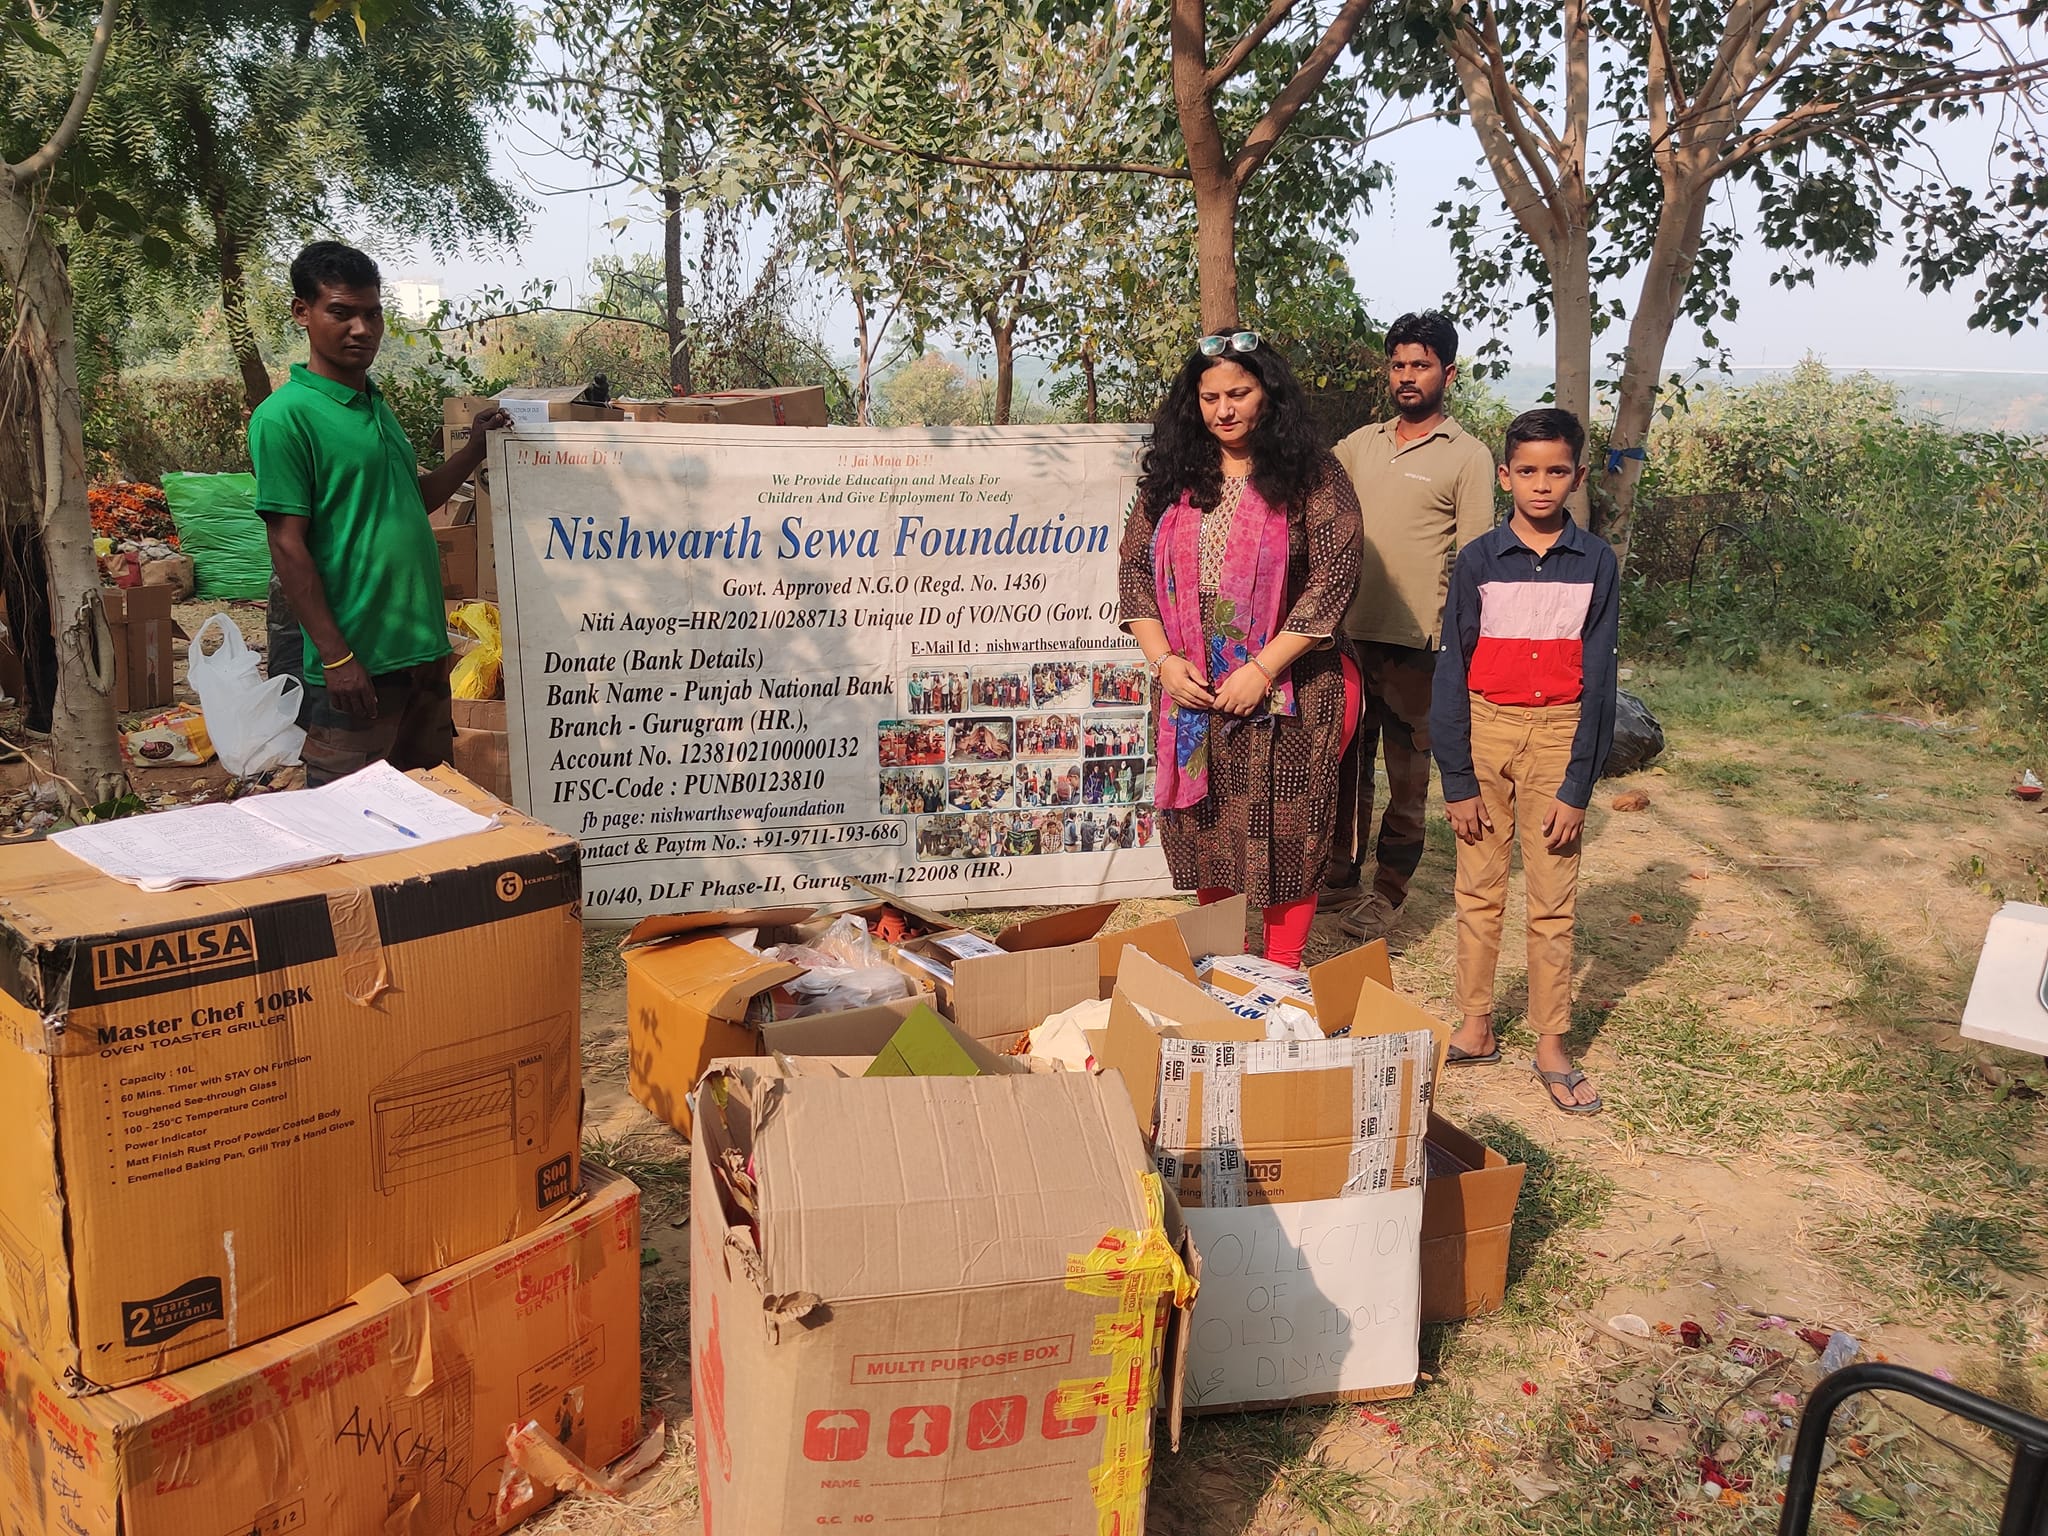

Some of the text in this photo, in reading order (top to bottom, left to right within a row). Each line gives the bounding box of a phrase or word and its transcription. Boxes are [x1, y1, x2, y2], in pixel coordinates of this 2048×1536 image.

[532, 450, 551, 466] Jai
[555, 451, 588, 465] Mata
[592, 450, 608, 465] Di
[851, 454, 869, 468] Jai
[873, 455, 901, 467] Mata
[906, 455, 919, 467] Di
[771, 474, 1000, 486] We Provide Education and Meals For
[758, 491, 1014, 506] Children And Give Employment To Needy
[544, 513, 1110, 560] Nishwarth Sewa Foundation
[722, 572, 1048, 600] Govt. Approved N.G.O (Regd. No. 1436)
[580, 612, 615, 632] Niti
[853, 608, 914, 631] Unique
[918, 606, 941, 626] ID
[945, 606, 965, 629] of
[970, 603, 1042, 625] VO/NGO
[1046, 603, 1093, 626] (Govt.
[544, 648, 764, 675] Donate (Bank Details)
[911, 640, 955, 655] E-Mail
[958, 640, 971, 654] Id
[546, 675, 895, 706] Bank Name Punjab National Bank
[549, 715, 622, 739] Branch
[643, 711, 744, 738] Gurugram
[750, 709, 808, 734] (HR.),
[550, 736, 859, 771] Account No. 1238102100000132
[552, 776, 664, 803] IFSC-Code
[684, 769, 825, 796] PUNB0123810
[580, 800, 845, 833] fb page: nishwarthsewafoundation
[580, 825, 899, 859] ontact & Paytm No.: +91-9711-193-686
[585, 886, 643, 908] 10/40,
[648, 881, 695, 901] DLF
[700, 875, 786, 897] Phase-II,
[964, 861, 1013, 882] (HR.)
[100, 924, 252, 978] INALSA
[97, 985, 314, 1046] Master Chef 10BK
[101, 1014, 286, 1058] OVEN TOASTER GRILLER
[119, 1065, 195, 1087] Capacity 10L
[121, 1055, 312, 1103] 60 Mins. Timer with STAY ON Function
[122, 1079, 277, 1120] Toughened See-through Glass
[124, 1124, 143, 1135] 100
[186, 1102, 249, 1122] Temperature
[251, 1092, 288, 1107] Control
[125, 1128, 208, 1152] Power Indicator
[126, 1108, 342, 1168] Matt Finish Rust Proof Powder Coated Body
[185, 1156, 221, 1172] Baking
[223, 1150, 246, 1163] Pan,
[248, 1142, 269, 1156] Grill
[271, 1137, 291, 1151] Tray
[302, 1127, 327, 1140] Hand
[329, 1119, 355, 1133] Glove
[542, 1162, 567, 1187] 800
[1255, 1188, 1285, 1197] Health
[1207, 1215, 1421, 1278] OLLECTION
[152, 1299, 191, 1317] years
[1247, 1282, 1290, 1313] OF
[129, 1301, 213, 1338] 2 warranty
[1197, 1300, 1401, 1354] OLD IDOLS
[866, 1344, 1060, 1377] MULTI PURPOSE BOX
[821, 1479, 862, 1489] NAME
[816, 1514, 875, 1525] G.C. NO
